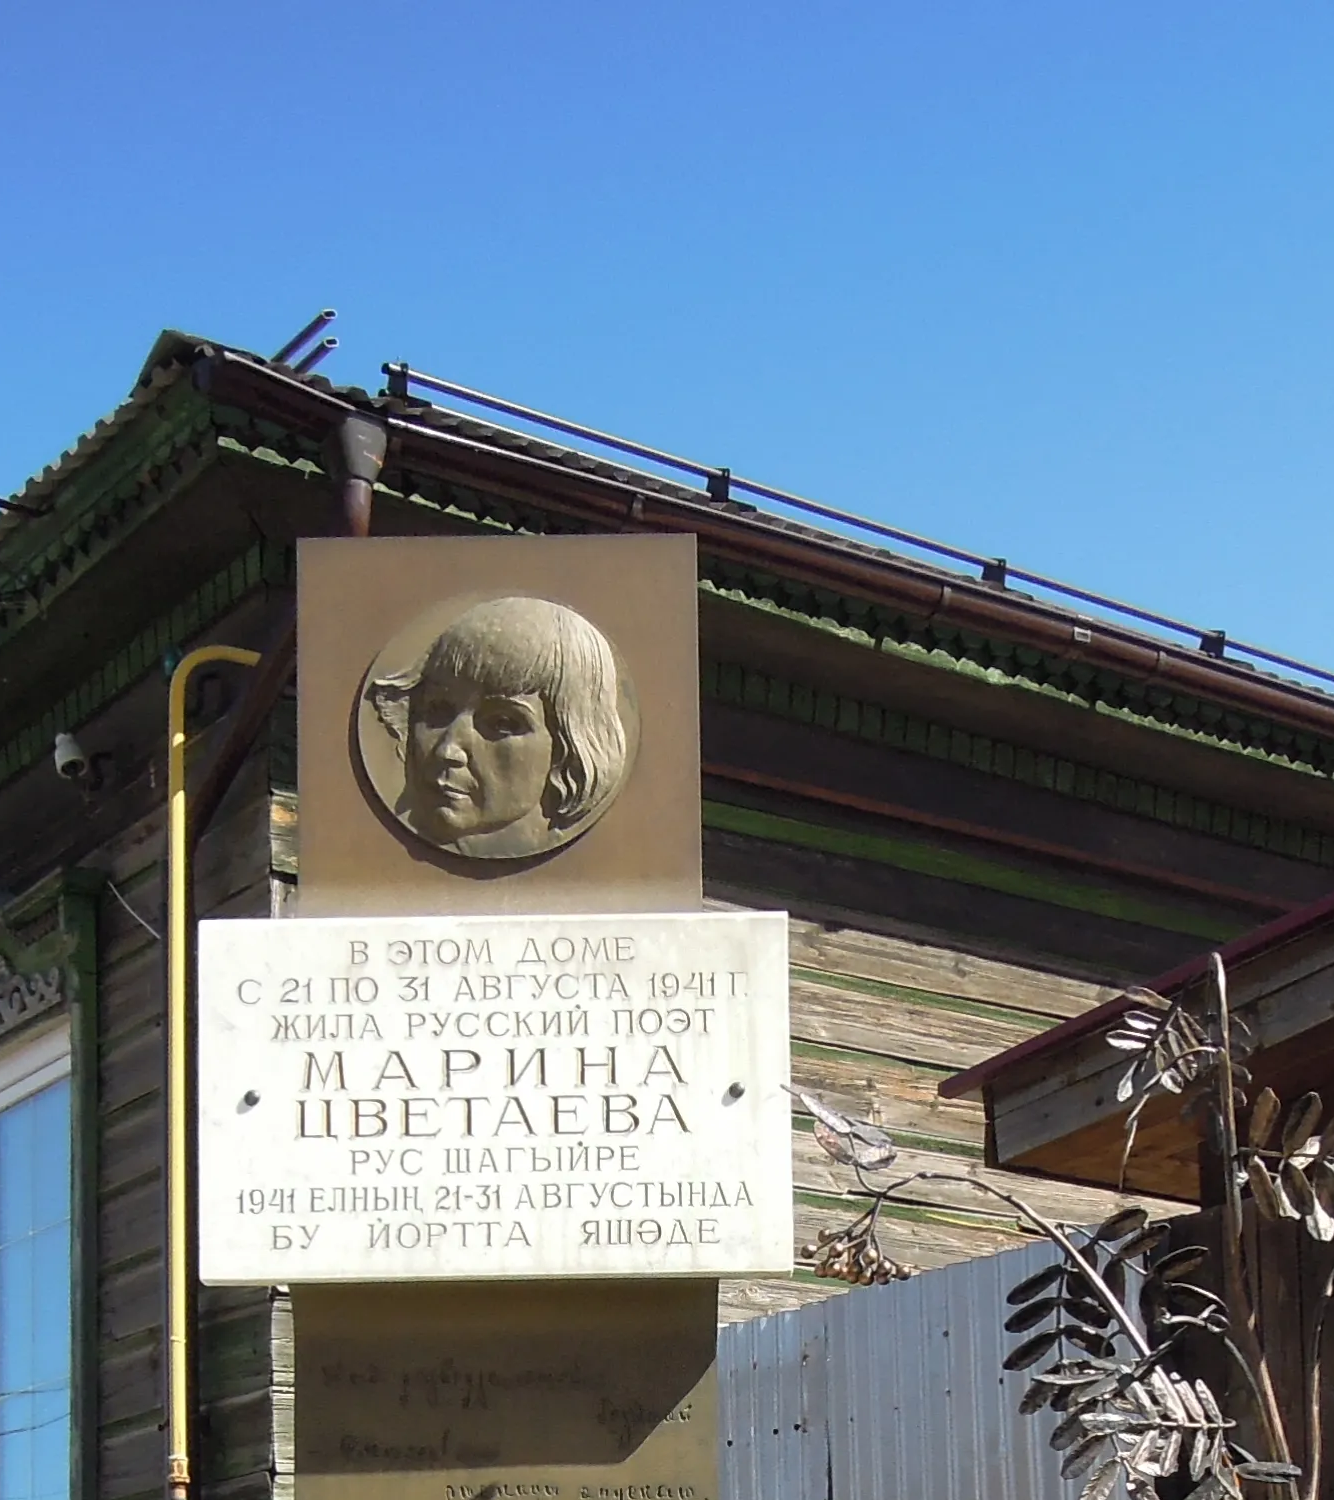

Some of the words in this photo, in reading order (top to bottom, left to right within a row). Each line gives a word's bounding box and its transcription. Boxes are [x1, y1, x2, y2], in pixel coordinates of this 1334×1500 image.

[349, 940, 370, 966] В
[387, 938, 494, 966] ЭТОМ
[516, 936, 636, 967] ДОМЕ
[236, 978, 263, 1005] С
[279, 977, 313, 1004] 21
[328, 976, 380, 1005] ПО
[398, 975, 432, 1002] 31
[454, 972, 631, 1002] АВГУСТА
[648, 971, 716, 999] 1941
[728, 970, 750, 998] Г.
[270, 1012, 385, 1042] ЖИЛА
[404, 1004, 590, 1041] РУССКИЙ
[611, 1007, 716, 1037] ПОЭТ
[301, 1044, 690, 1093] МАРИНА
[293, 1093, 692, 1141] ЦВЕТАЕВА
[349, 1148, 424, 1177] РУС
[442, 1139, 641, 1176] ШАГЫЙРЕ
[236, 1186, 297, 1215] 1941
[309, 1185, 424, 1214] ЕЛНЫҢ
[434, 1183, 502, 1212] 21-31
[513, 1180, 755, 1211] АВГУСТЫНДА
[269, 1224, 321, 1252] БУ
[366, 1216, 533, 1250] ЙОРТТА
[578, 1217, 722, 1247] ЯШӘДЕ
